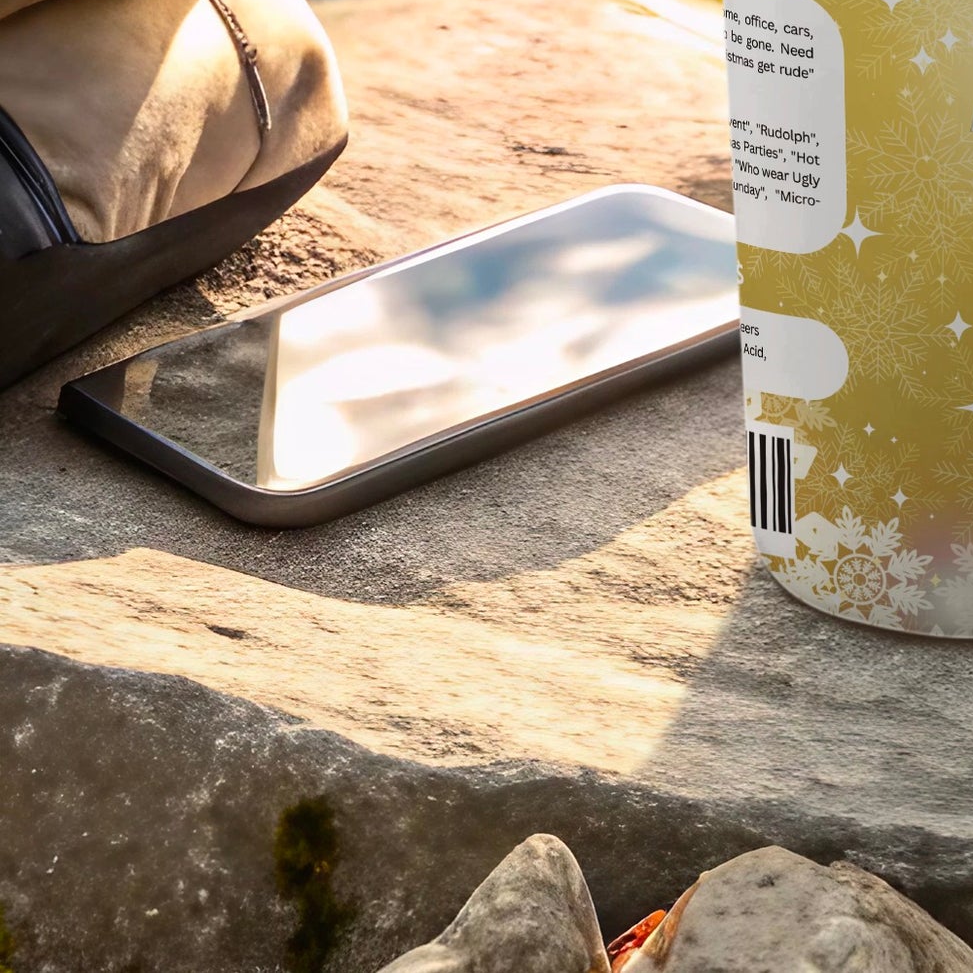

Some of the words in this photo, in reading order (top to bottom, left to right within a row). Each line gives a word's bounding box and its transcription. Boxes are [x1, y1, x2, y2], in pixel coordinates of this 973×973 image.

[744, 14, 778, 34] office,
[783, 24, 814, 40] cars,
[731, 30, 743, 44] be
[746, 37, 775, 52] gone.
[780, 42, 814, 59] Need
[757, 60, 775, 74] get
[779, 65, 814, 79] rude"
[756, 123, 820, 147] "Rudolph",
[743, 141, 787, 163] Parties",
[791, 150, 820, 166] "Hot
[735, 159, 760, 176] "Who
[761, 167, 790, 181] wear
[792, 171, 820, 188] Ugly
[775, 189, 821, 206] "Micro-
[743, 342, 767, 362] Acid,
